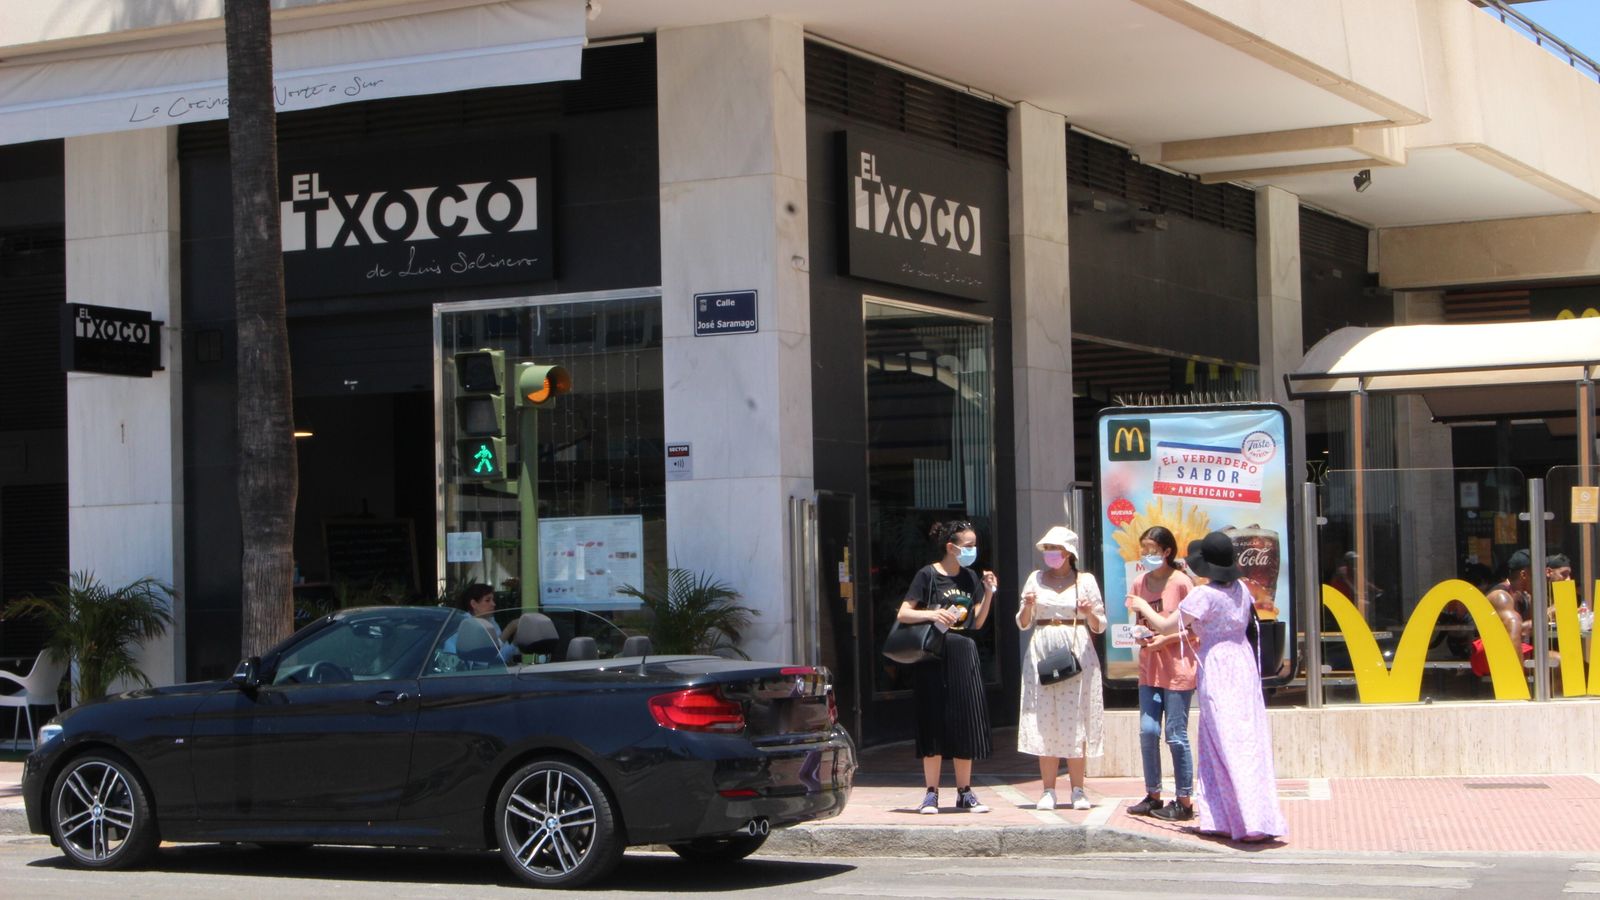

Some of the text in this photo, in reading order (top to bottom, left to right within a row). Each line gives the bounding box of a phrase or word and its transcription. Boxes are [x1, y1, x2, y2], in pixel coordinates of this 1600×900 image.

[861, 151, 882, 183] EL
[292, 172, 330, 201] EL
[290, 177, 528, 251] TXOCO
[858, 177, 979, 255] TXOCO
[79, 307, 91, 319] EL
[715, 298, 736, 307] Calle
[78, 318, 149, 343] TXOCO
[697, 319, 755, 330] José Saramago
[1162, 454, 1258, 475] EL VERDADERO
[1177, 465, 1240, 484] SABOR
[1177, 485, 1236, 499] AMERICANO
